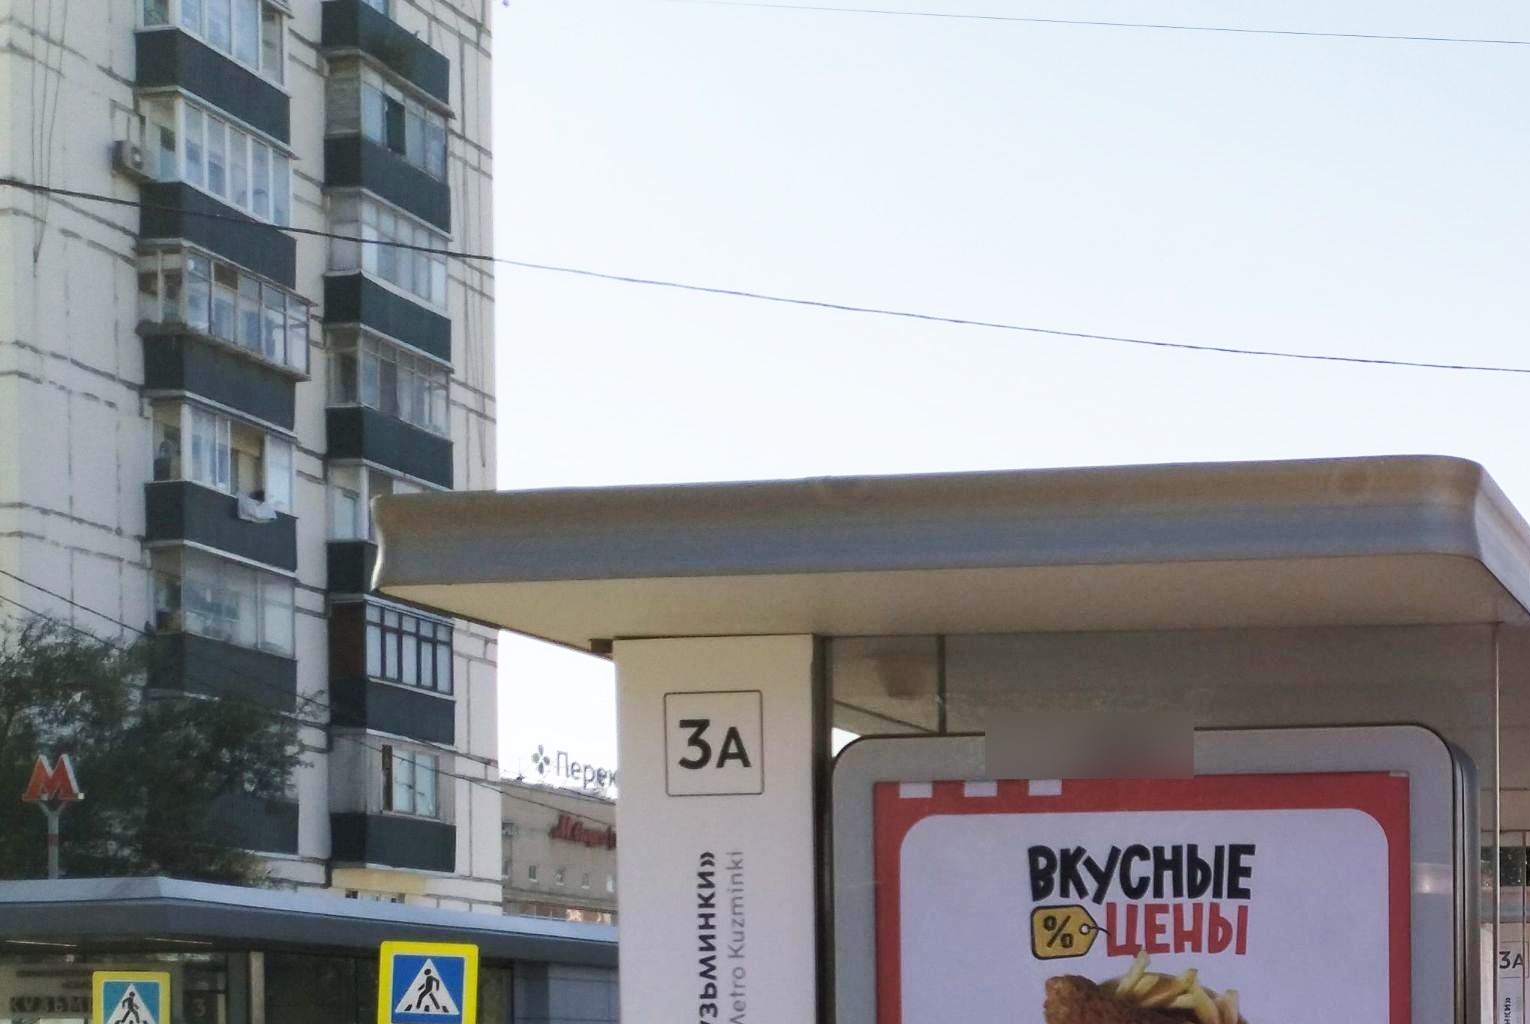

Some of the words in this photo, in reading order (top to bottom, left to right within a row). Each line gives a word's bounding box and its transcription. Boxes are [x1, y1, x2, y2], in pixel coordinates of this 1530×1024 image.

[556, 750, 617, 789] Перек
[678, 719, 752, 769] 3А
[1027, 844, 1256, 904] ВКУСНЫЕ
[727, 850, 745, 960] Kuzminki
[1106, 902, 1249, 956] ЦЕНЫ
